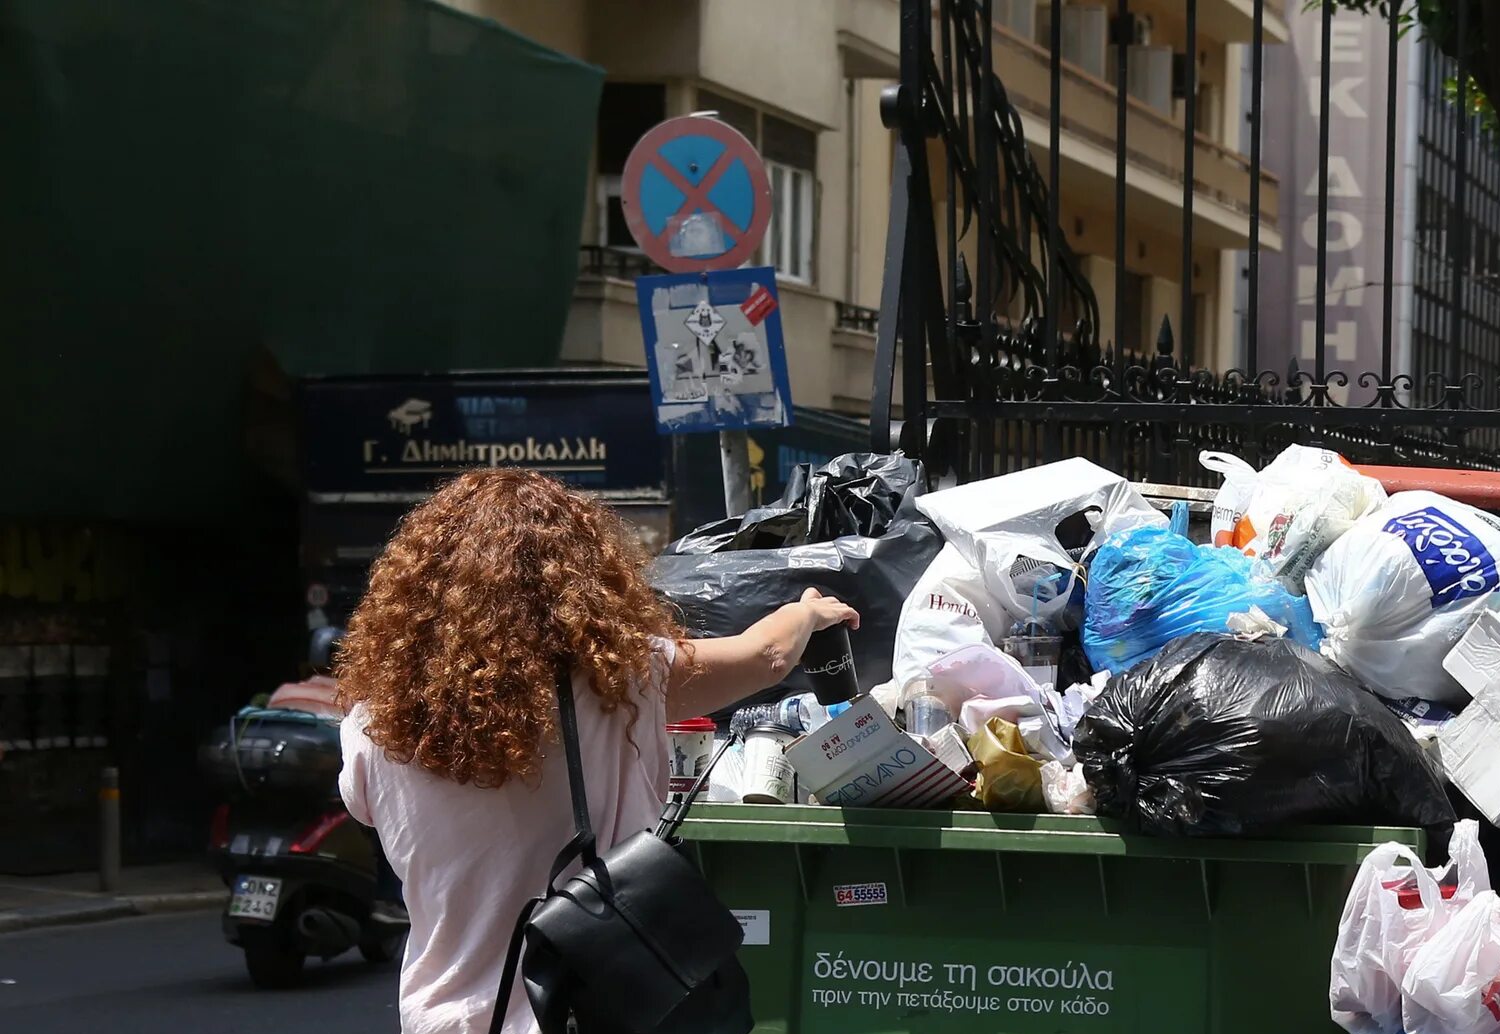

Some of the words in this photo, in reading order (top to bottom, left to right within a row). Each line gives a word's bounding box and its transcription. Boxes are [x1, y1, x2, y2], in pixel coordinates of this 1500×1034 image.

[1212, 504, 1242, 524] perma
[813, 951, 933, 988] δένουμε
[943, 962, 977, 991] τη
[987, 960, 1114, 991] σακούλα
[812, 988, 852, 1008] πριν
[857, 990, 891, 1010] την
[896, 988, 1001, 1014] πετάξουμε
[1006, 996, 1054, 1013] στον
[1060, 995, 1110, 1016] κάδο
